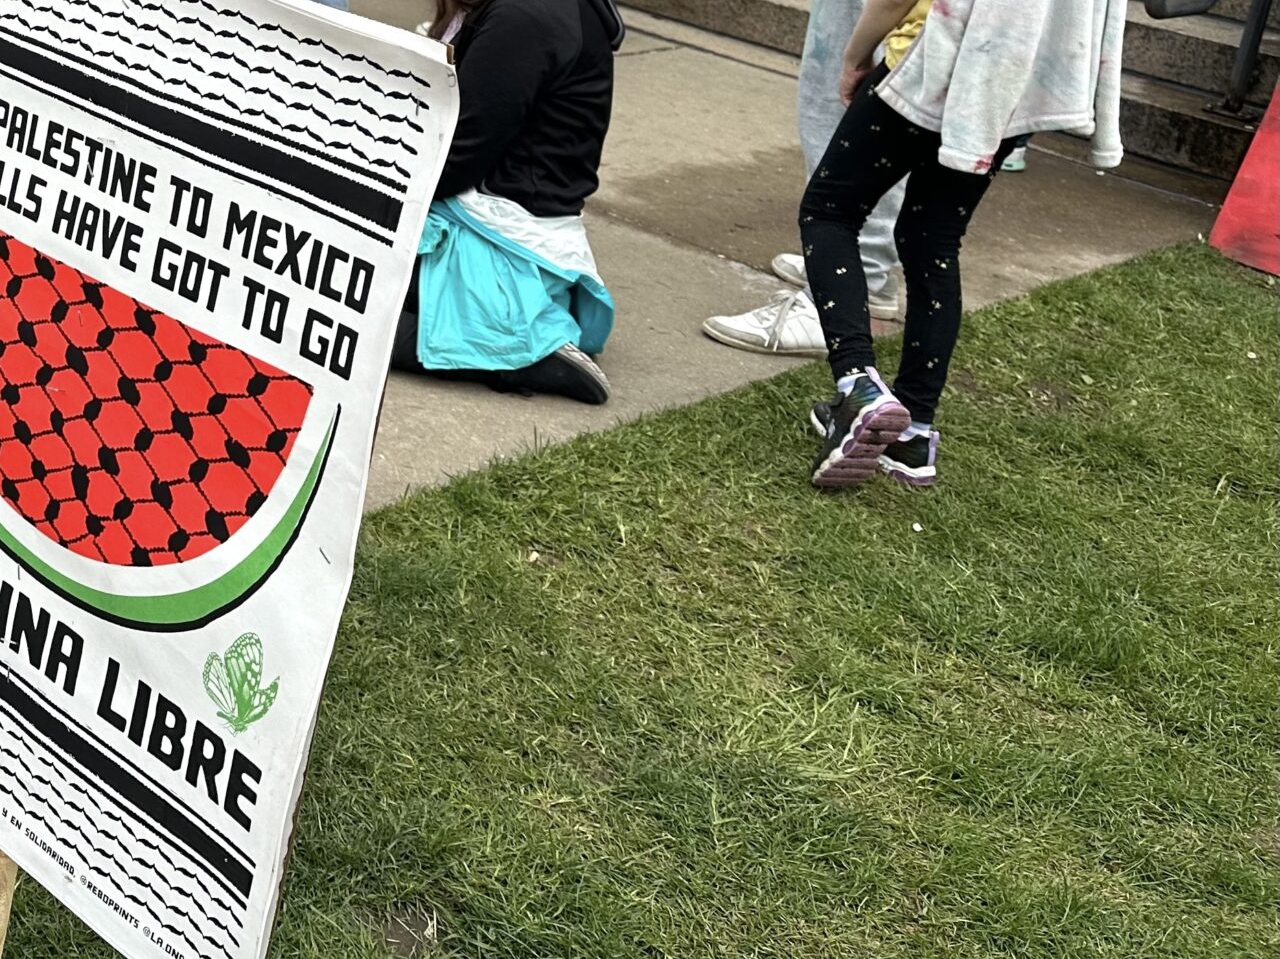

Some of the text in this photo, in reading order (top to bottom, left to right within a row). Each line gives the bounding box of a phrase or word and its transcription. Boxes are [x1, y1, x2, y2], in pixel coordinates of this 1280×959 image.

[51, 189, 144, 273] HAVE
[151, 237, 231, 313] GOT
[241, 276, 290, 345] TO
[299, 308, 359, 381] GO
[169, 175, 214, 239] TO
[223, 201, 376, 315] MEXICO
[96, 656, 263, 833] LIBRE
[1, 807, 8, 818] Y
[10, 816, 23, 830] EN
[25, 827, 77, 878] SOLIDARIDAD,
[80, 875, 141, 929] @REBOPRINTS
